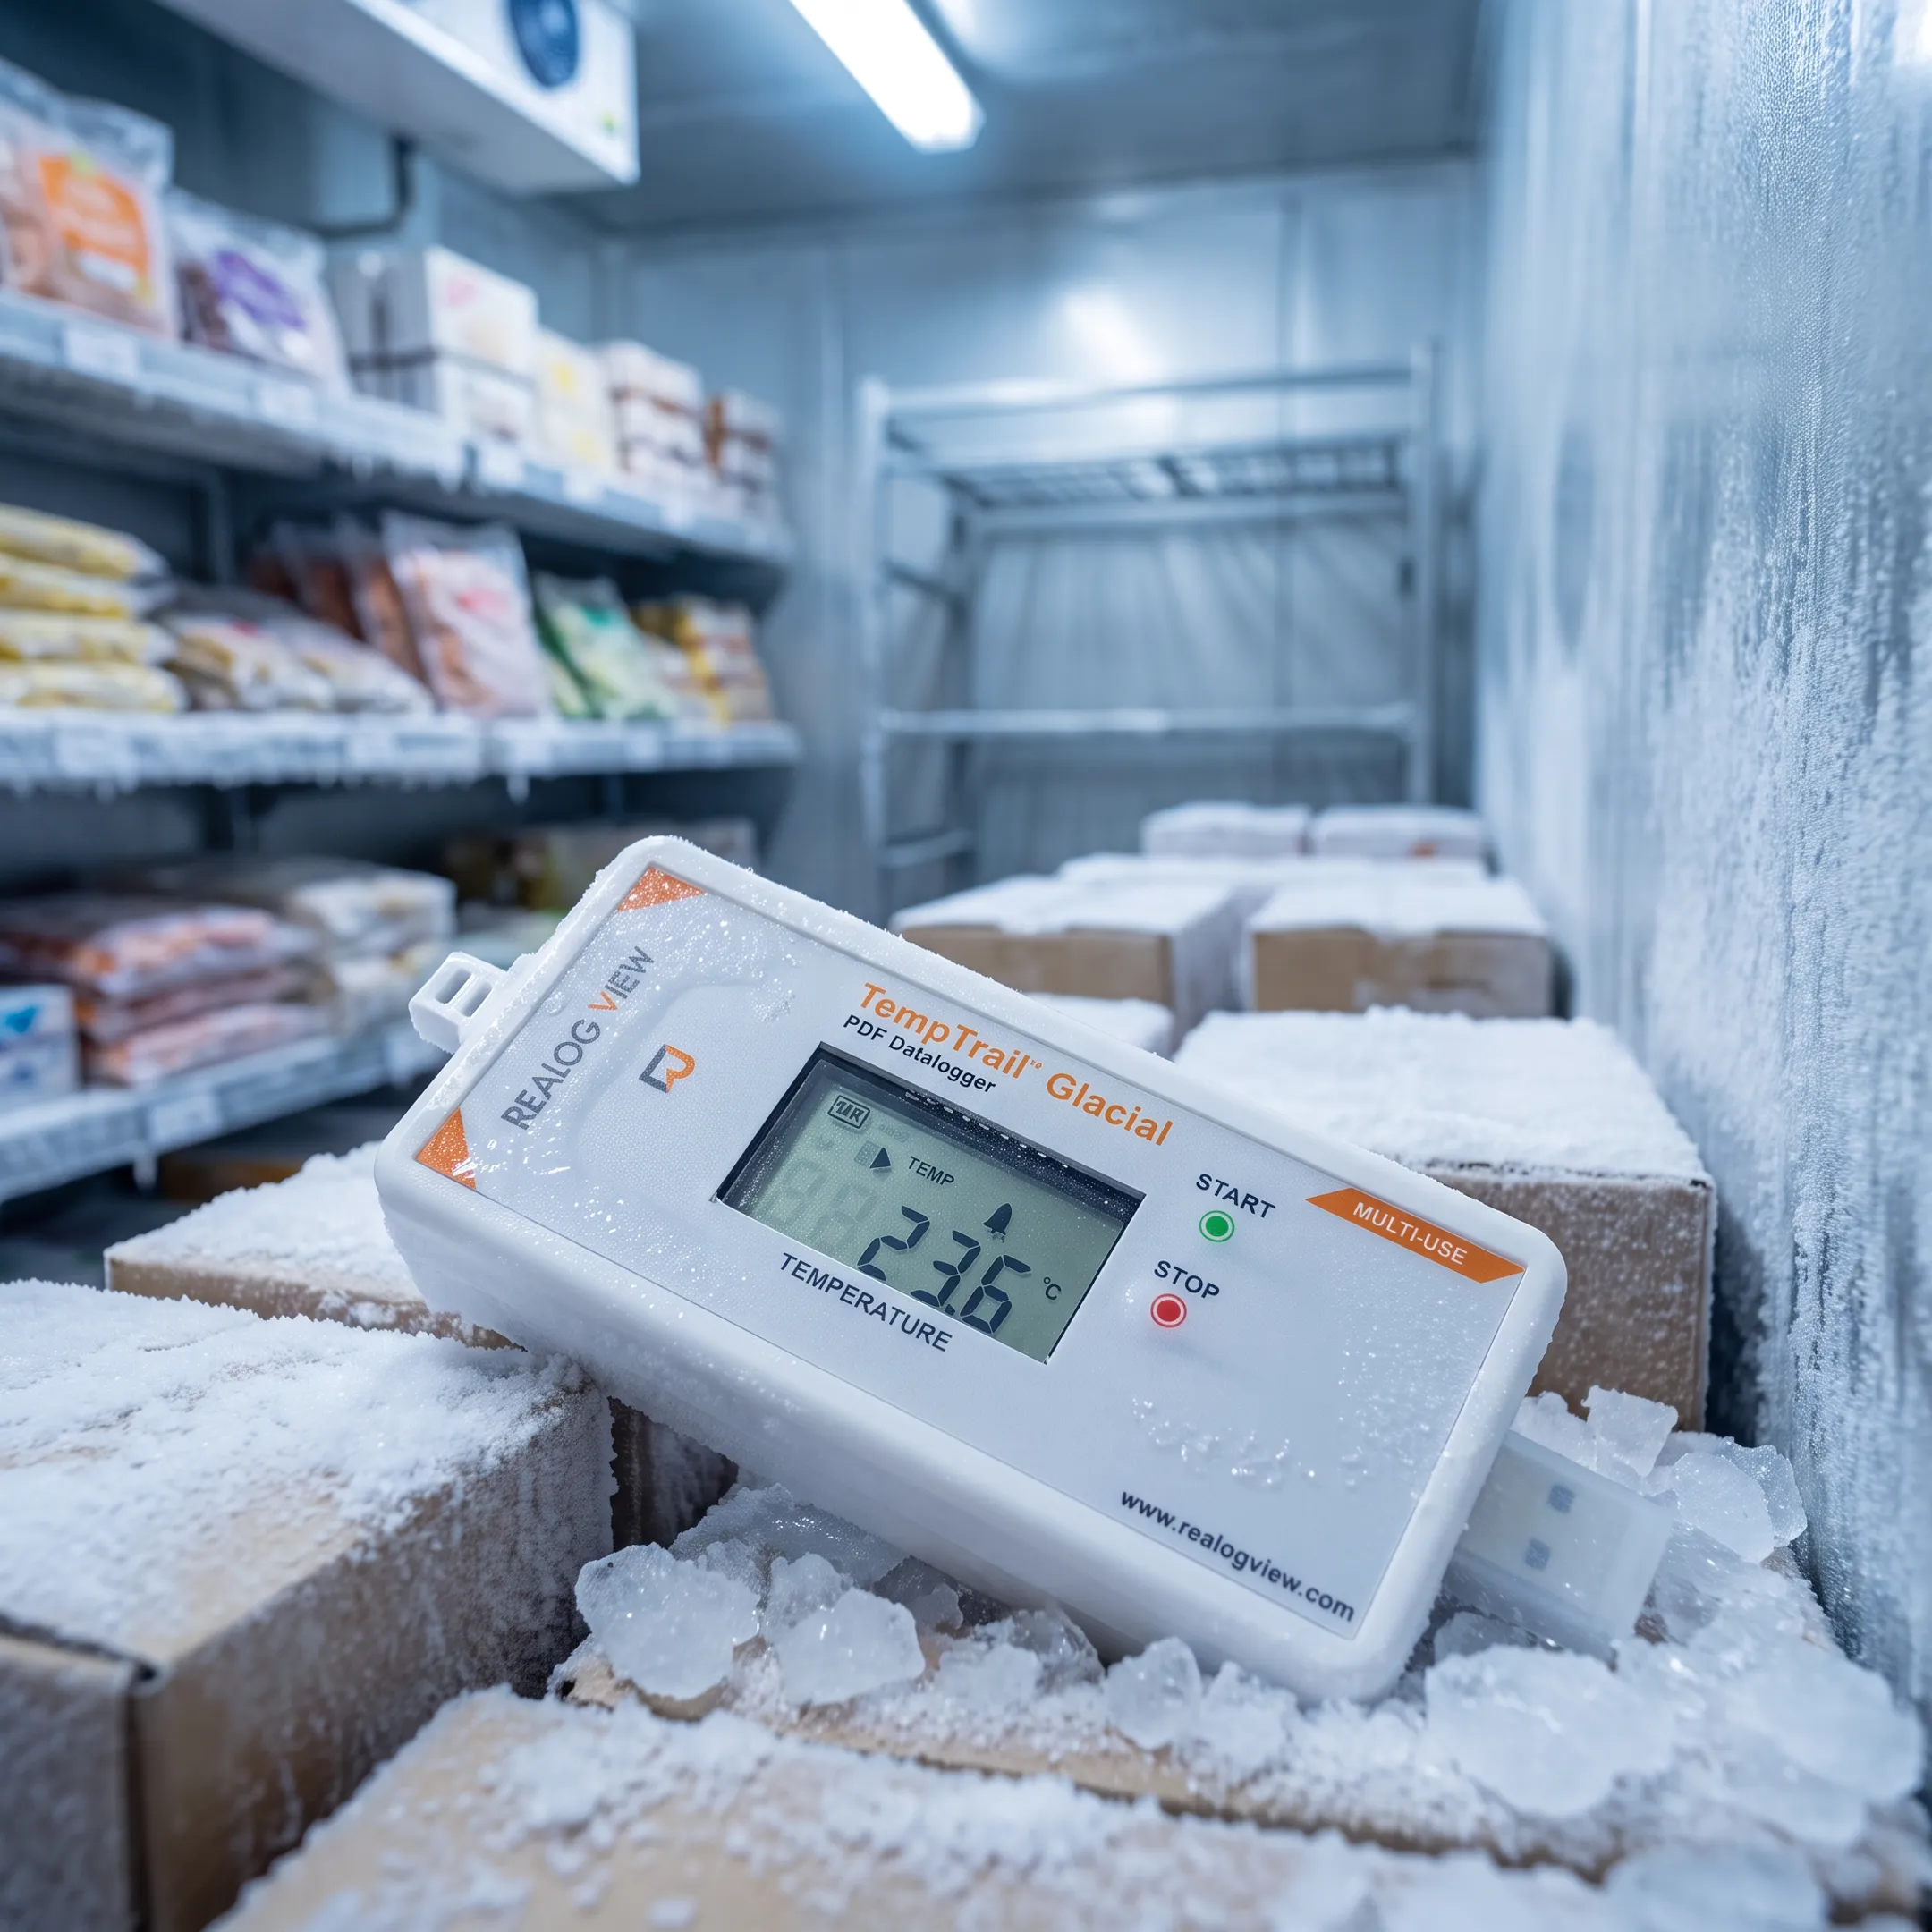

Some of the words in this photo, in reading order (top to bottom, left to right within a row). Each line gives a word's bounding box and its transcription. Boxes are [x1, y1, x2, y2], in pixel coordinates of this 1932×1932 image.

[500, 1019, 601, 1131] REALOG
[588, 945, 655, 1012] VIEW
[843, 1014, 888, 1041] PDF
[888, 1035, 996, 1093] Datalogger
[1046, 1072, 1173, 1146] Glacial
[908, 1156, 955, 1186] TEMP
[1195, 1173, 1276, 1219] START
[1352, 1201, 1468, 1265] MULTI-USE
[780, 1252, 953, 1352] TEMPERATURE
[1154, 1260, 1220, 1300] STOP
[1121, 1491, 1354, 1622] www.realogview.com
